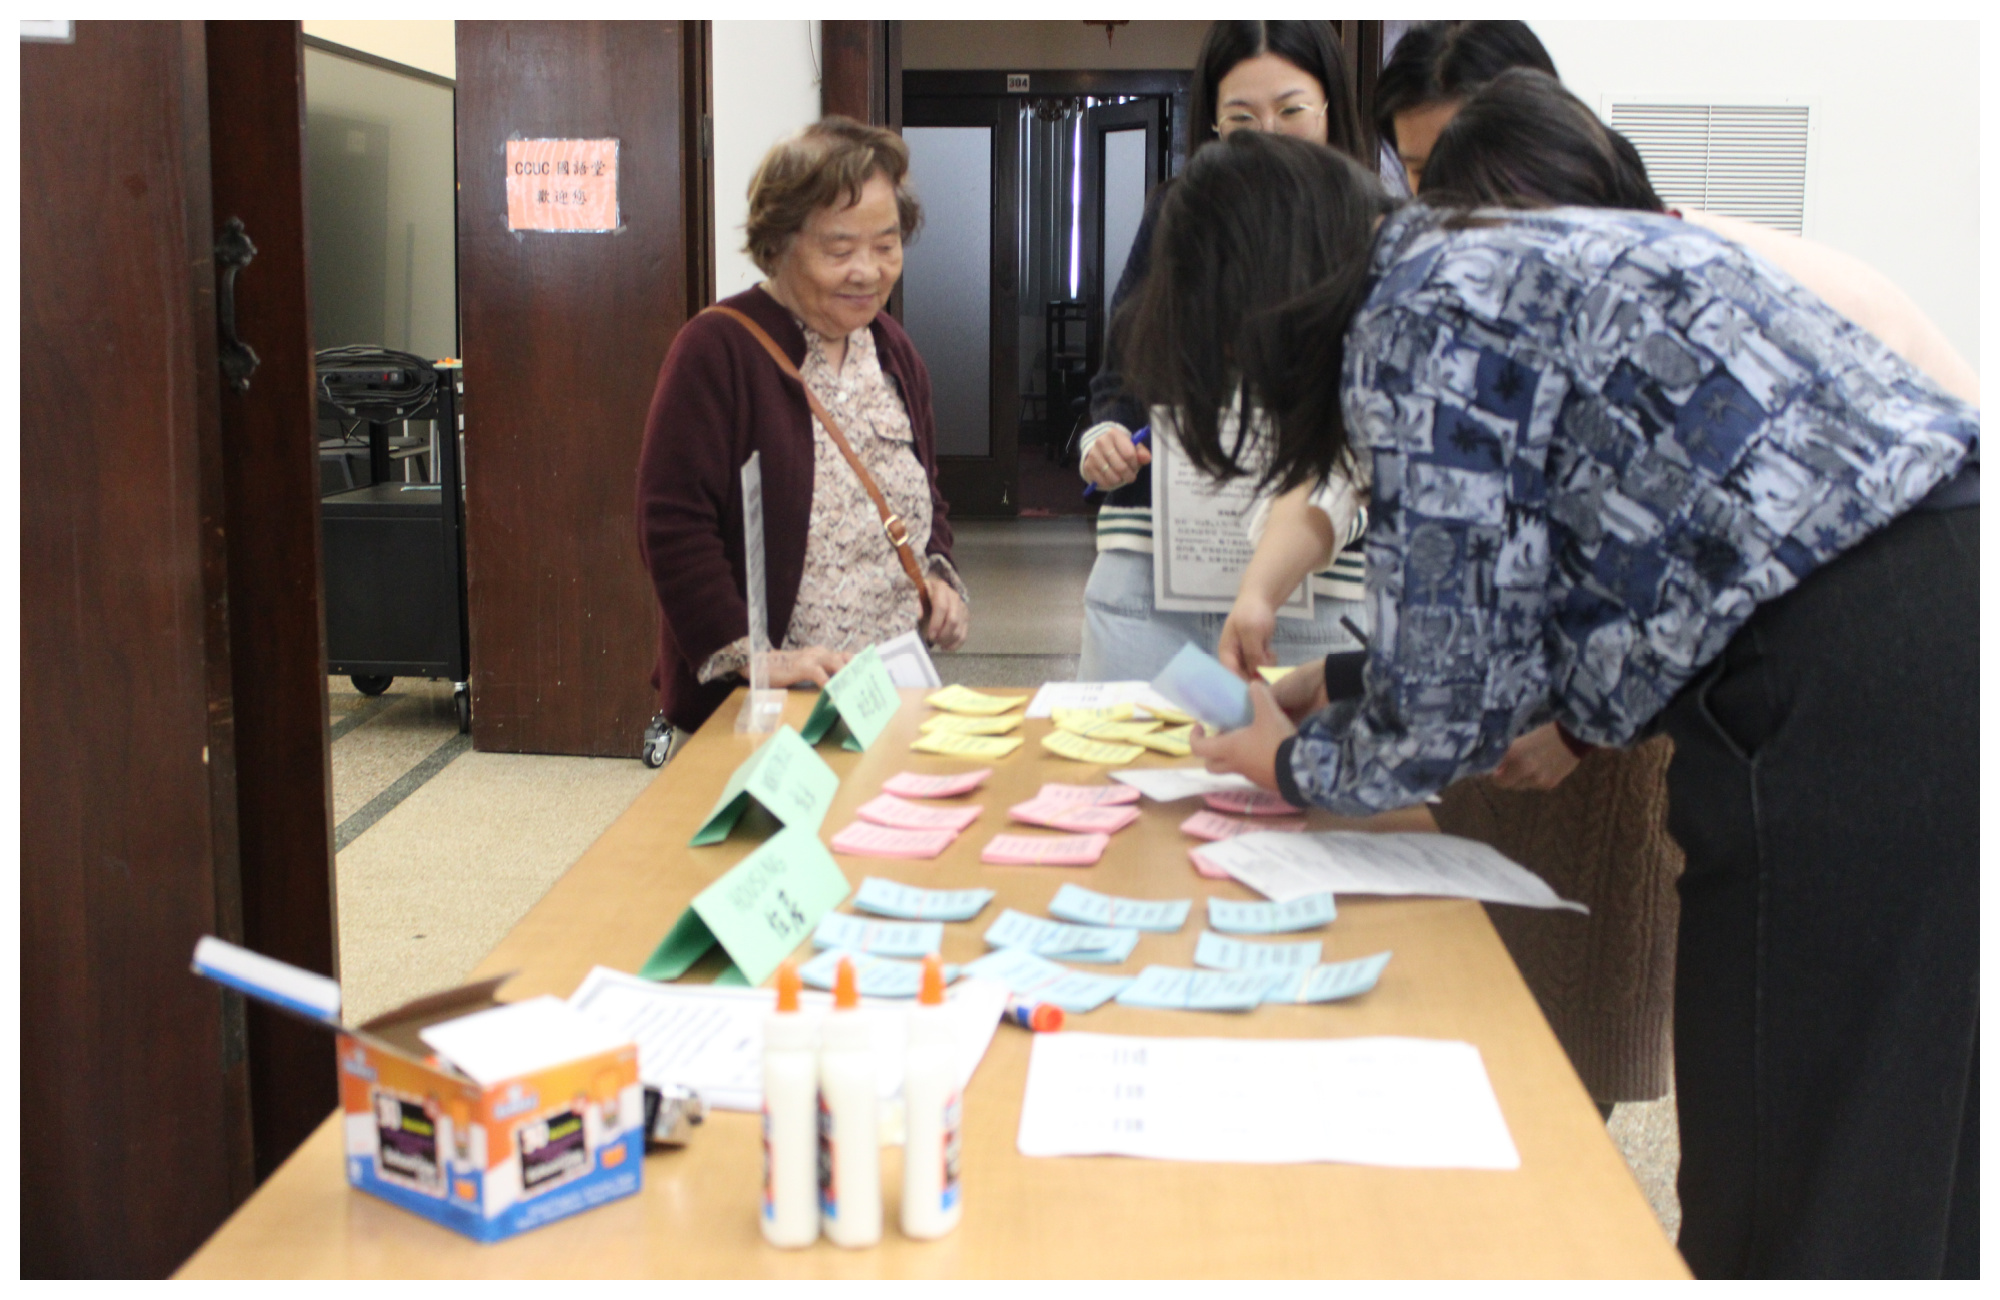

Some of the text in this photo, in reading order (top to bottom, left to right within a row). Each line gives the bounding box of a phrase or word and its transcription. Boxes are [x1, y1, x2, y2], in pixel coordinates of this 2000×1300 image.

[514, 160, 606, 177] CCUC 國語堂
[538, 188, 587, 205] 歡迎您
